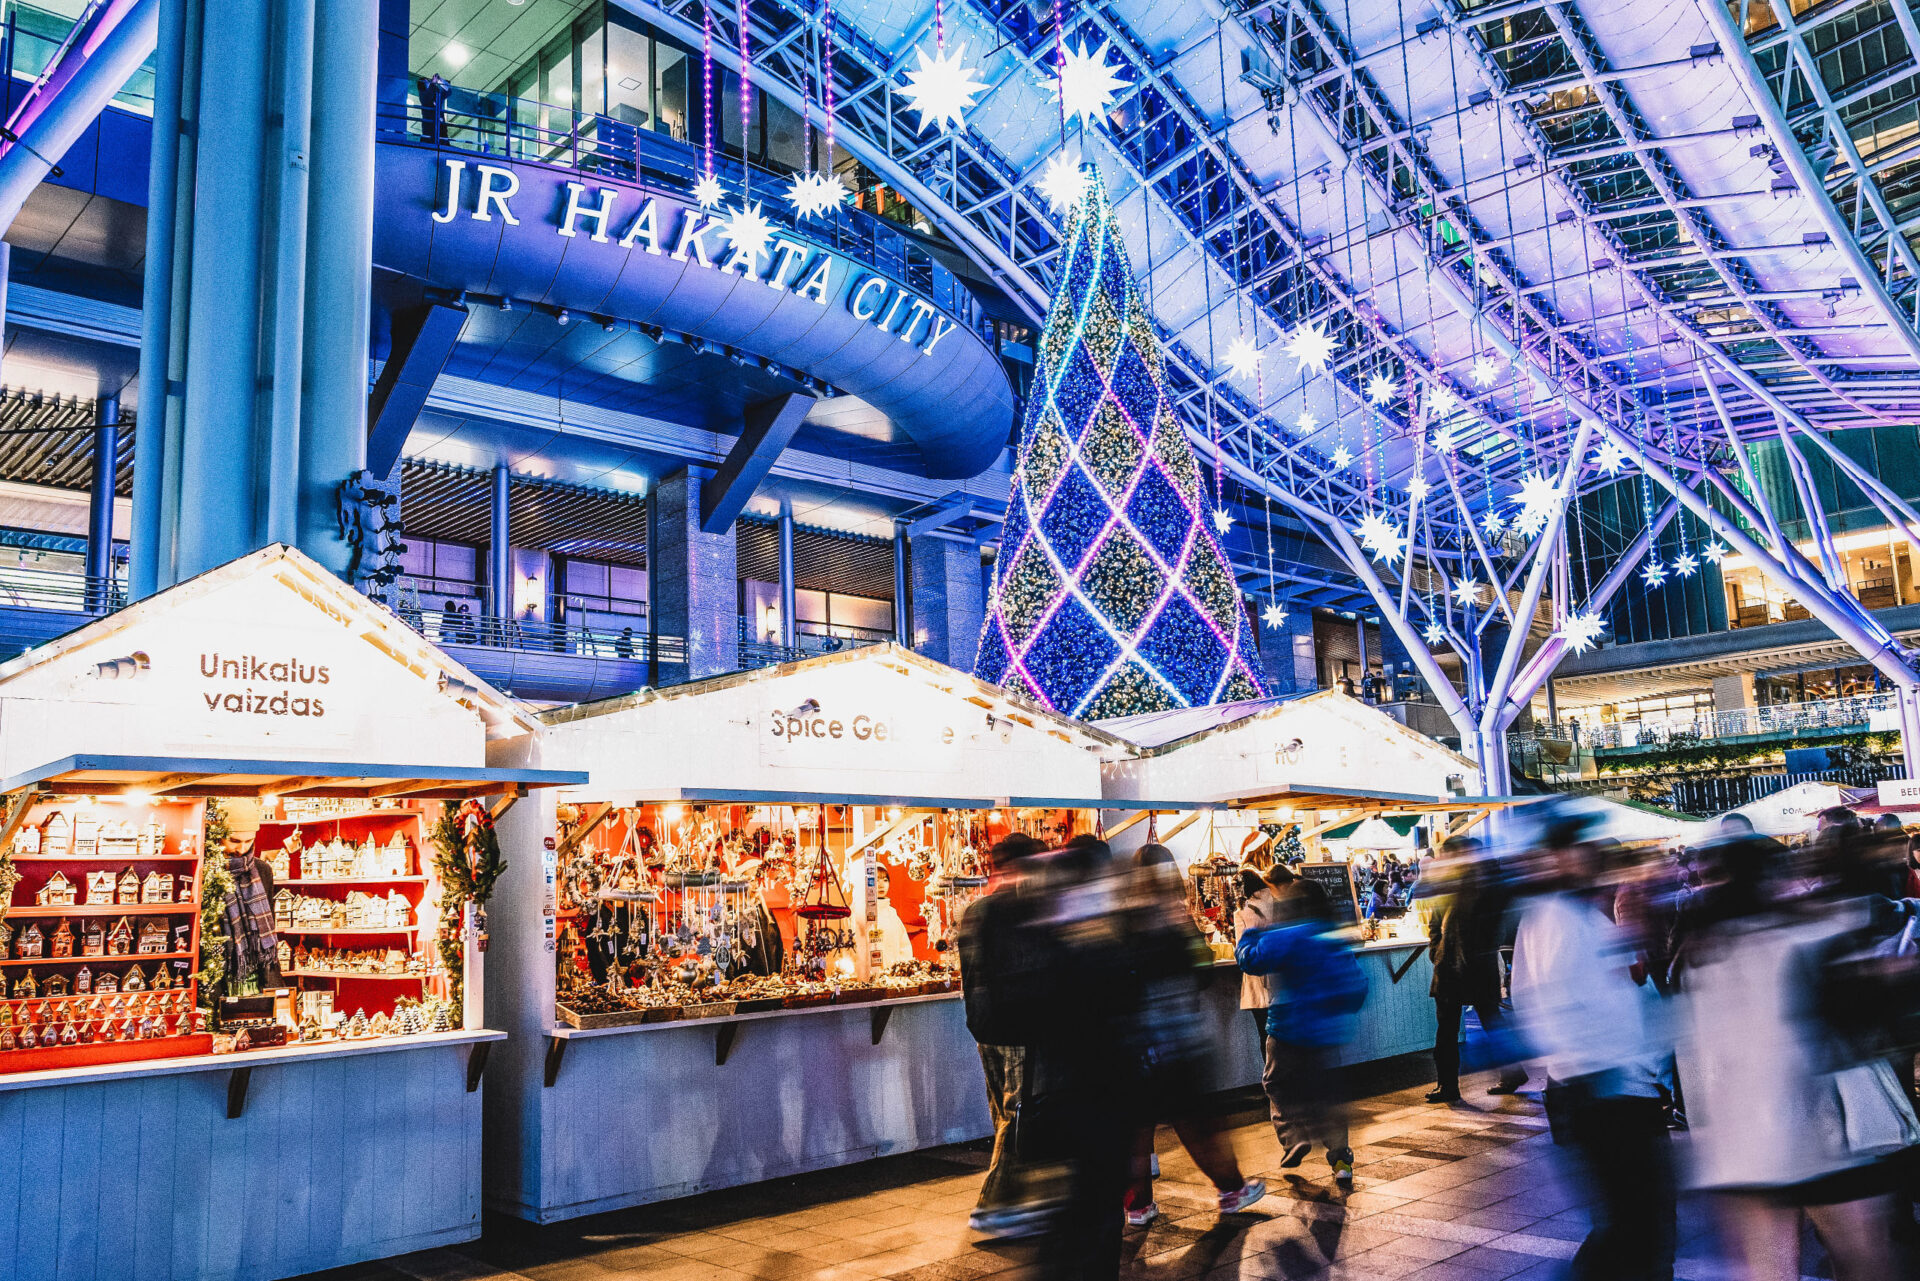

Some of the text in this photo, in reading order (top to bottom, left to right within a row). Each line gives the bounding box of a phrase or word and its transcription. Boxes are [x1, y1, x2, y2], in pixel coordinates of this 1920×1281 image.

[432, 159, 958, 358] JR HAKATA CITY
[200, 652, 330, 685] Unikalus
[203, 687, 325, 717] vaizdas
[771, 709, 844, 743] Spice
